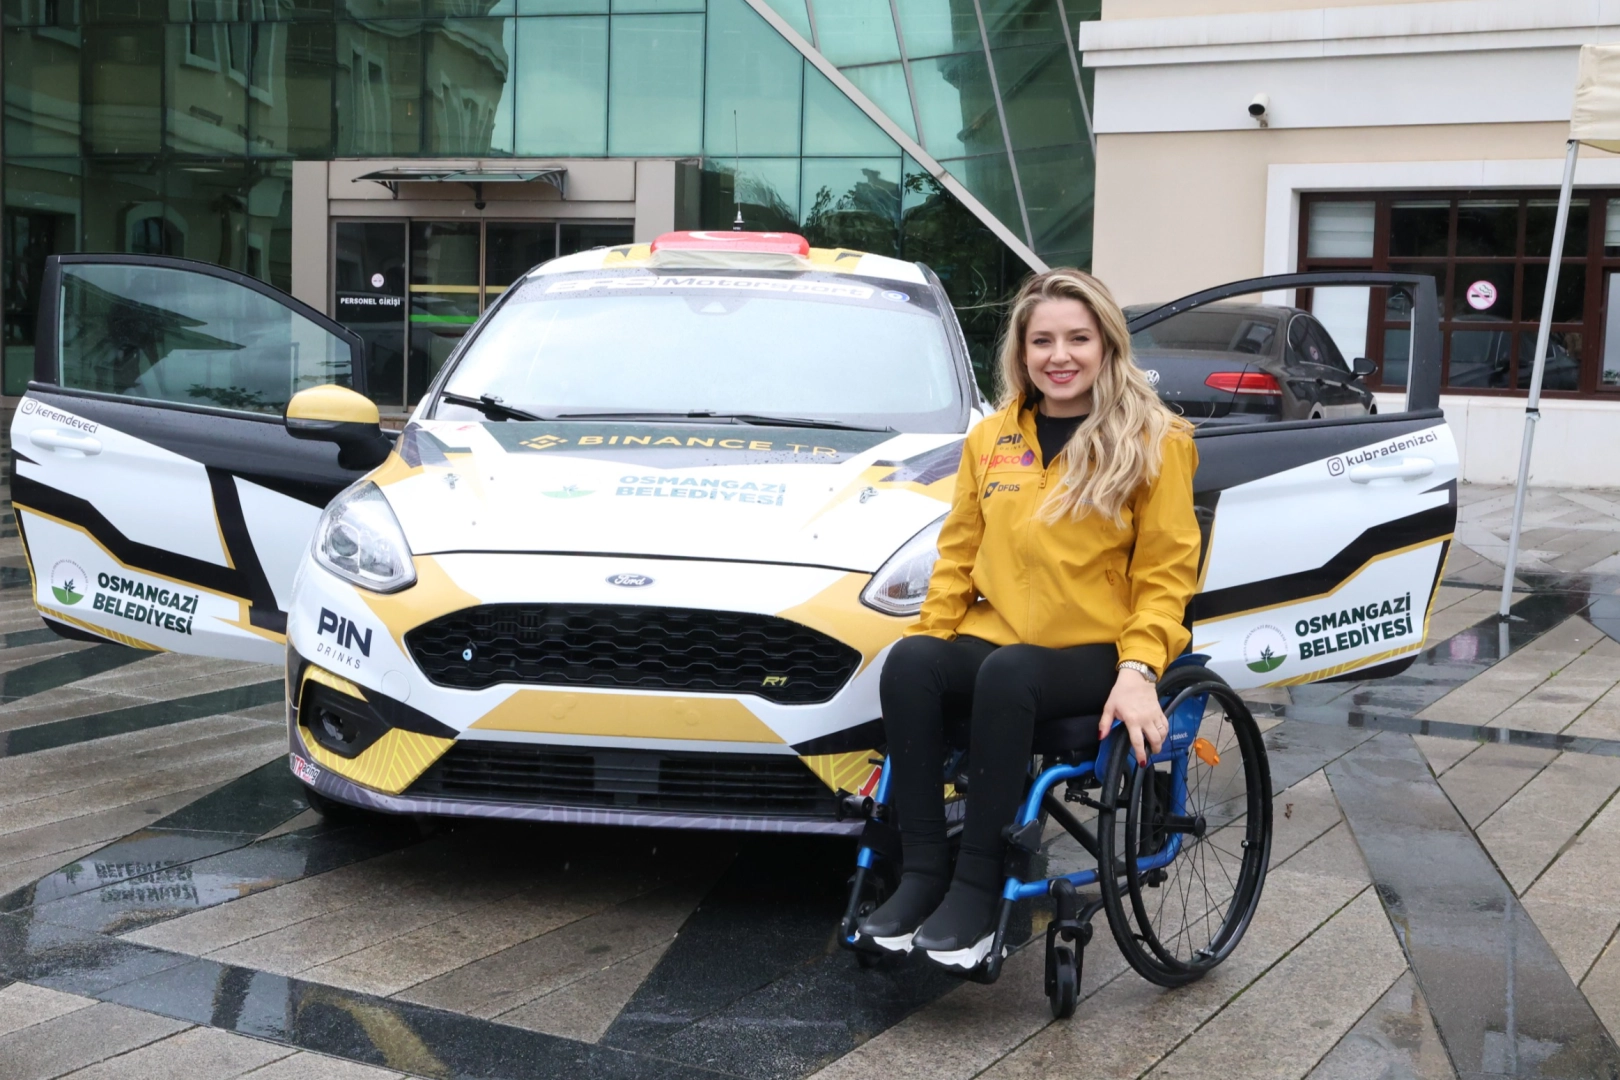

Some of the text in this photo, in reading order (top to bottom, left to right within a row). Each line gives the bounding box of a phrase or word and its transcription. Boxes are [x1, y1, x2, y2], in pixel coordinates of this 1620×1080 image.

[663, 277, 864, 297] Motorsport
[340, 297, 401, 307] PERSONEL GİRİŞİ
[35, 405, 99, 434] keremdeveci
[577, 435, 837, 457] BINANCE TR
[1345, 431, 1438, 466] kubradenizci
[615, 486, 784, 507] BELEDİYESİ
[619, 475, 787, 494] OSMANGAZİ
[997, 484, 1020, 492] DFDS
[614, 574, 646, 586] Ford
[98, 572, 199, 615] OSMANGAZİ
[92, 592, 193, 635] BELEDİYESİ
[1295, 592, 1411, 637] OSMANGAZİ
[317, 606, 373, 658] PIN
[1299, 613, 1413, 660] BELEDİYESİ
[317, 642, 361, 669] DRINKS
[762, 676, 788, 686] R1
